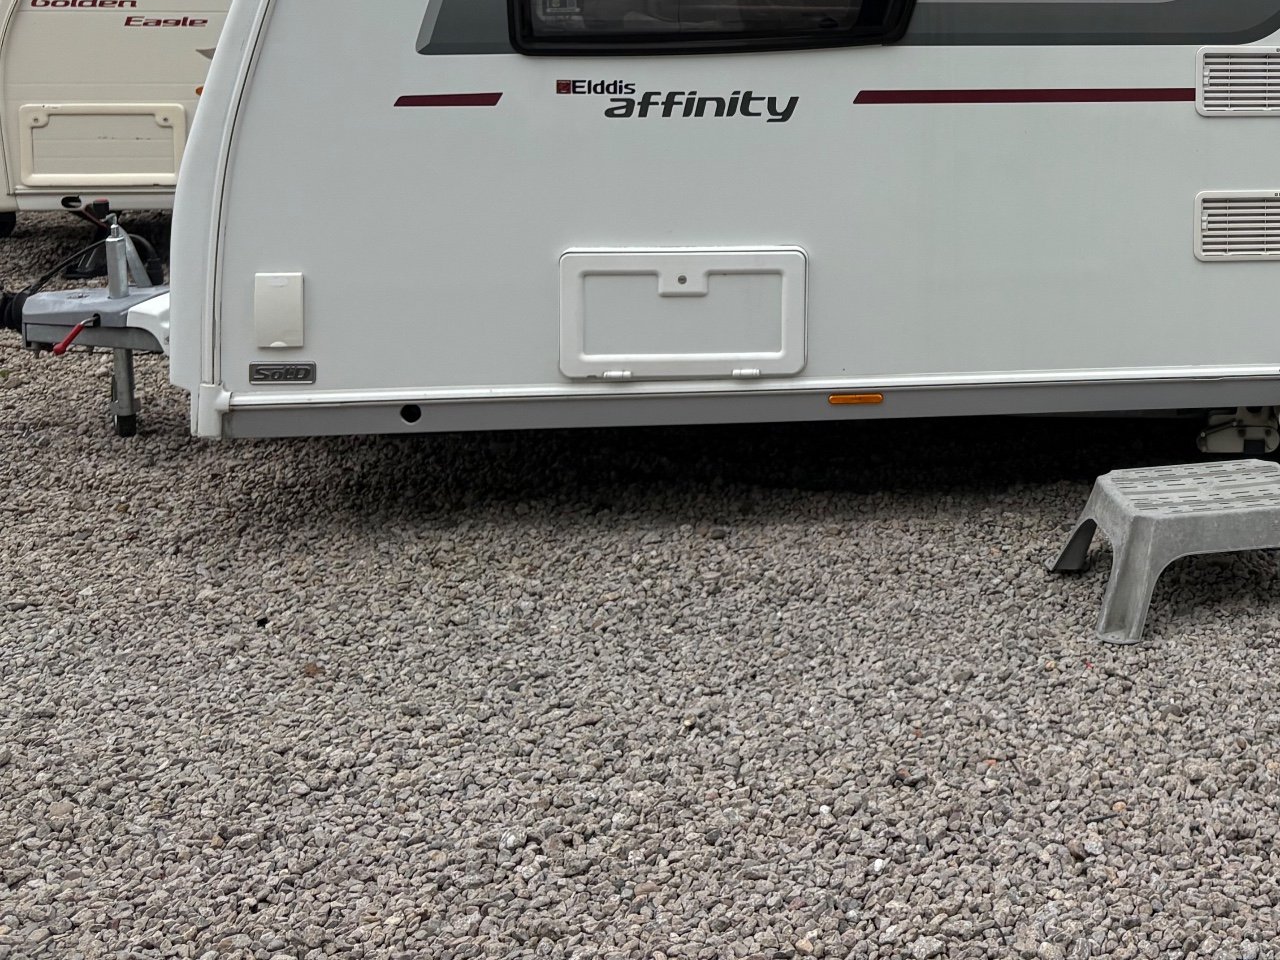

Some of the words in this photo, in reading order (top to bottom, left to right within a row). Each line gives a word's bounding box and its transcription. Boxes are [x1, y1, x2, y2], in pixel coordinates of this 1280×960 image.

[124, 15, 208, 27] Eagle
[571, 79, 636, 95] Elddis
[604, 90, 800, 123] affinity
